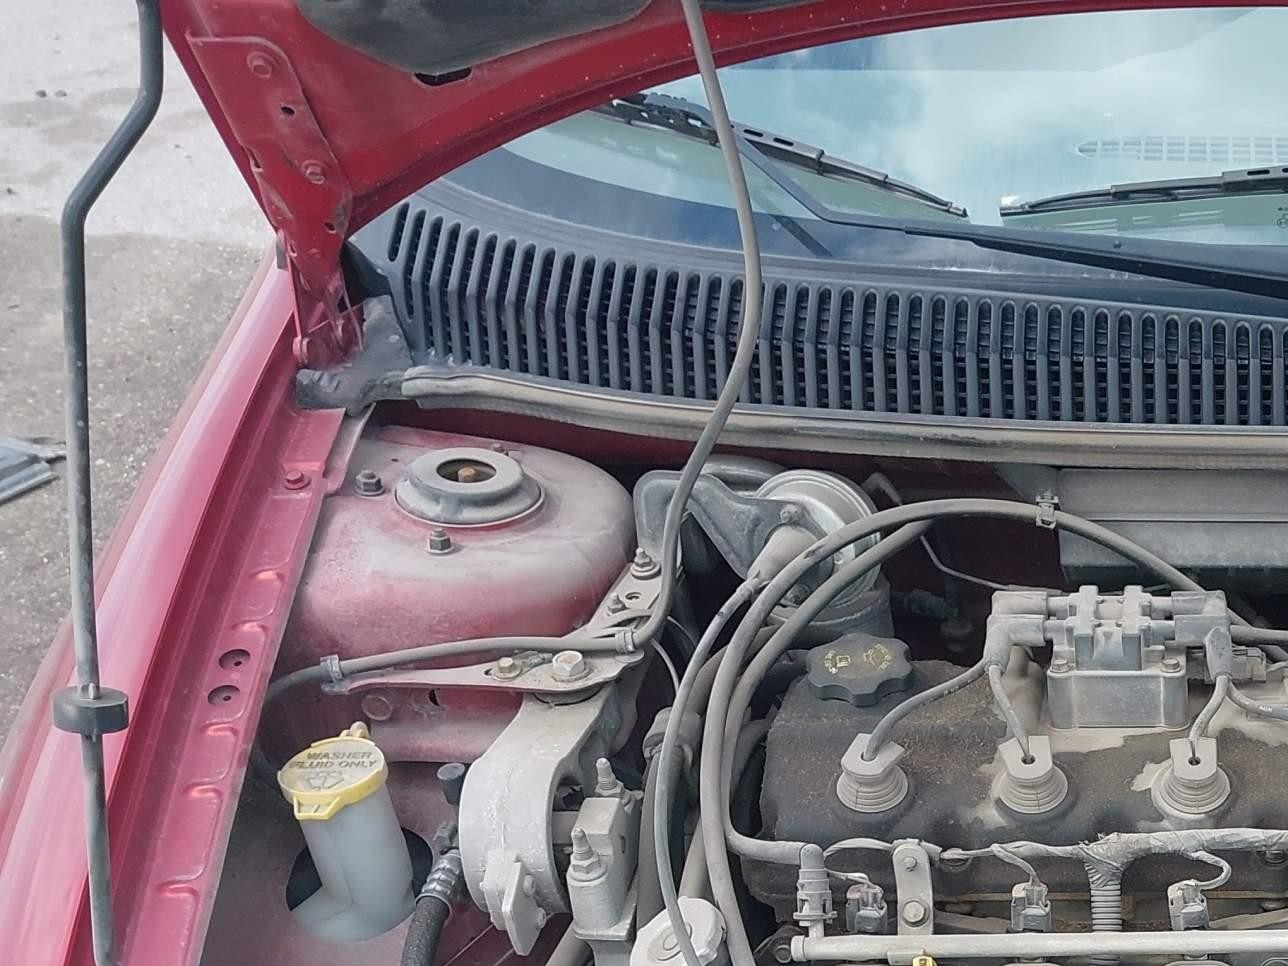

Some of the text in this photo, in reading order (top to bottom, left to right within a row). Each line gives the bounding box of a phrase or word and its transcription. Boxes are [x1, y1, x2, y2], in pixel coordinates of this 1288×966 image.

[307, 751, 373, 761] WASHER
[288, 759, 378, 769] FLUID ONLY
